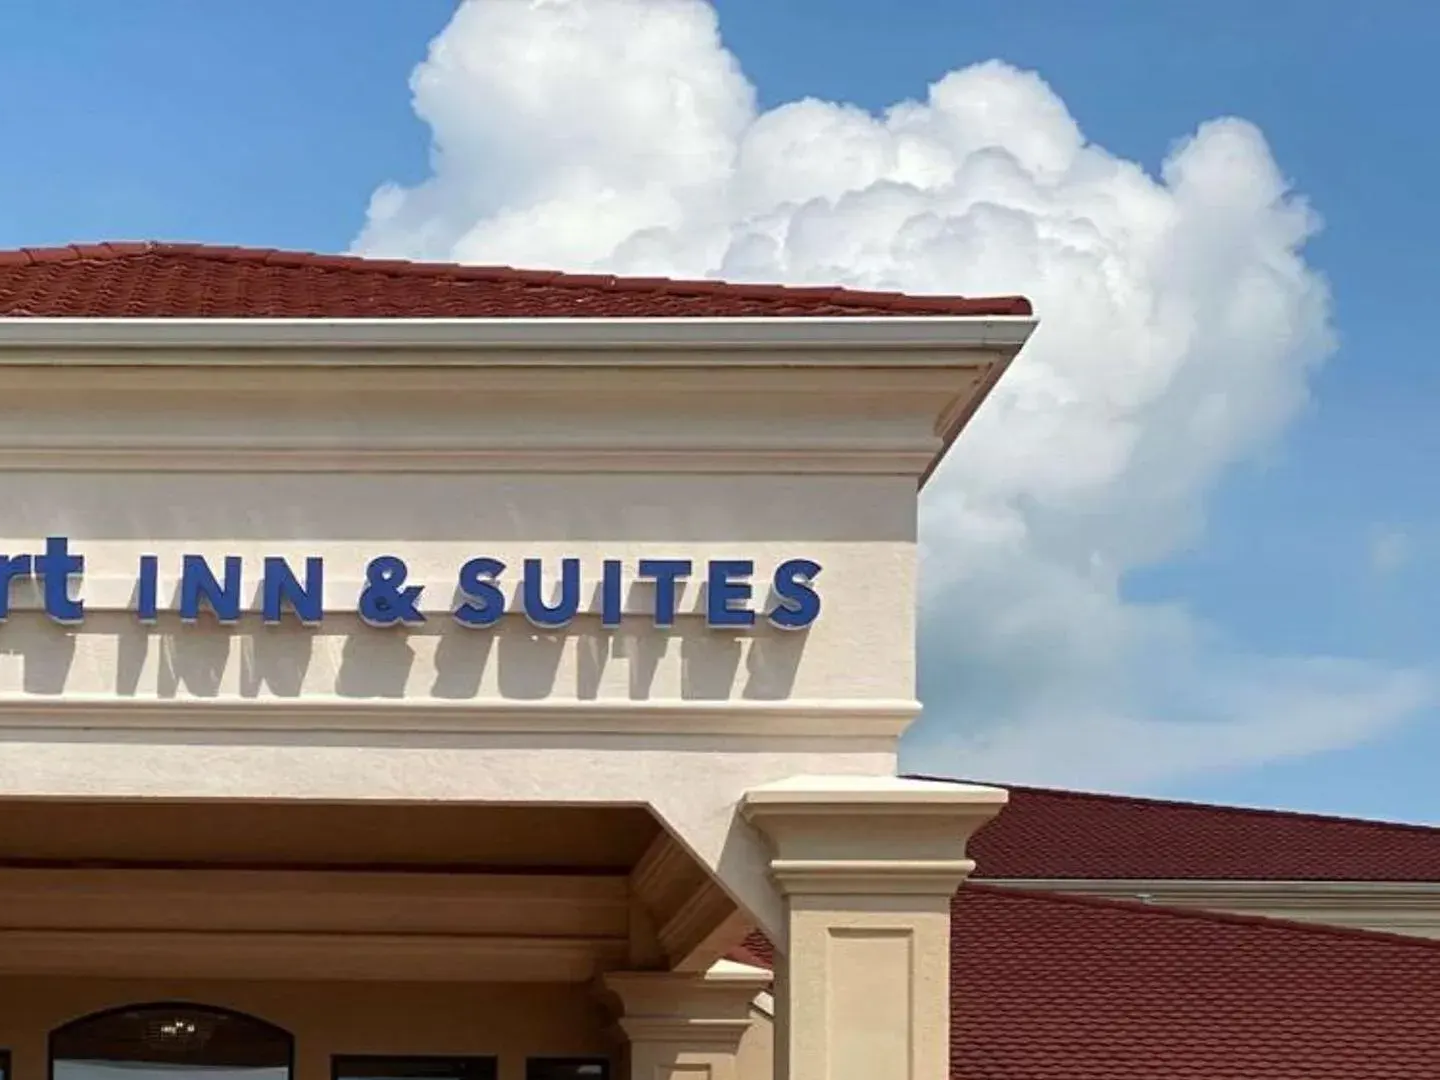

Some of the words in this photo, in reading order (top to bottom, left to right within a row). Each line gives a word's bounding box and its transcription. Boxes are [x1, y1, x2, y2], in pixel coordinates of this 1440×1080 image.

[137, 555, 324, 626] INN
[358, 555, 427, 627] &
[453, 557, 824, 630] SUITES
